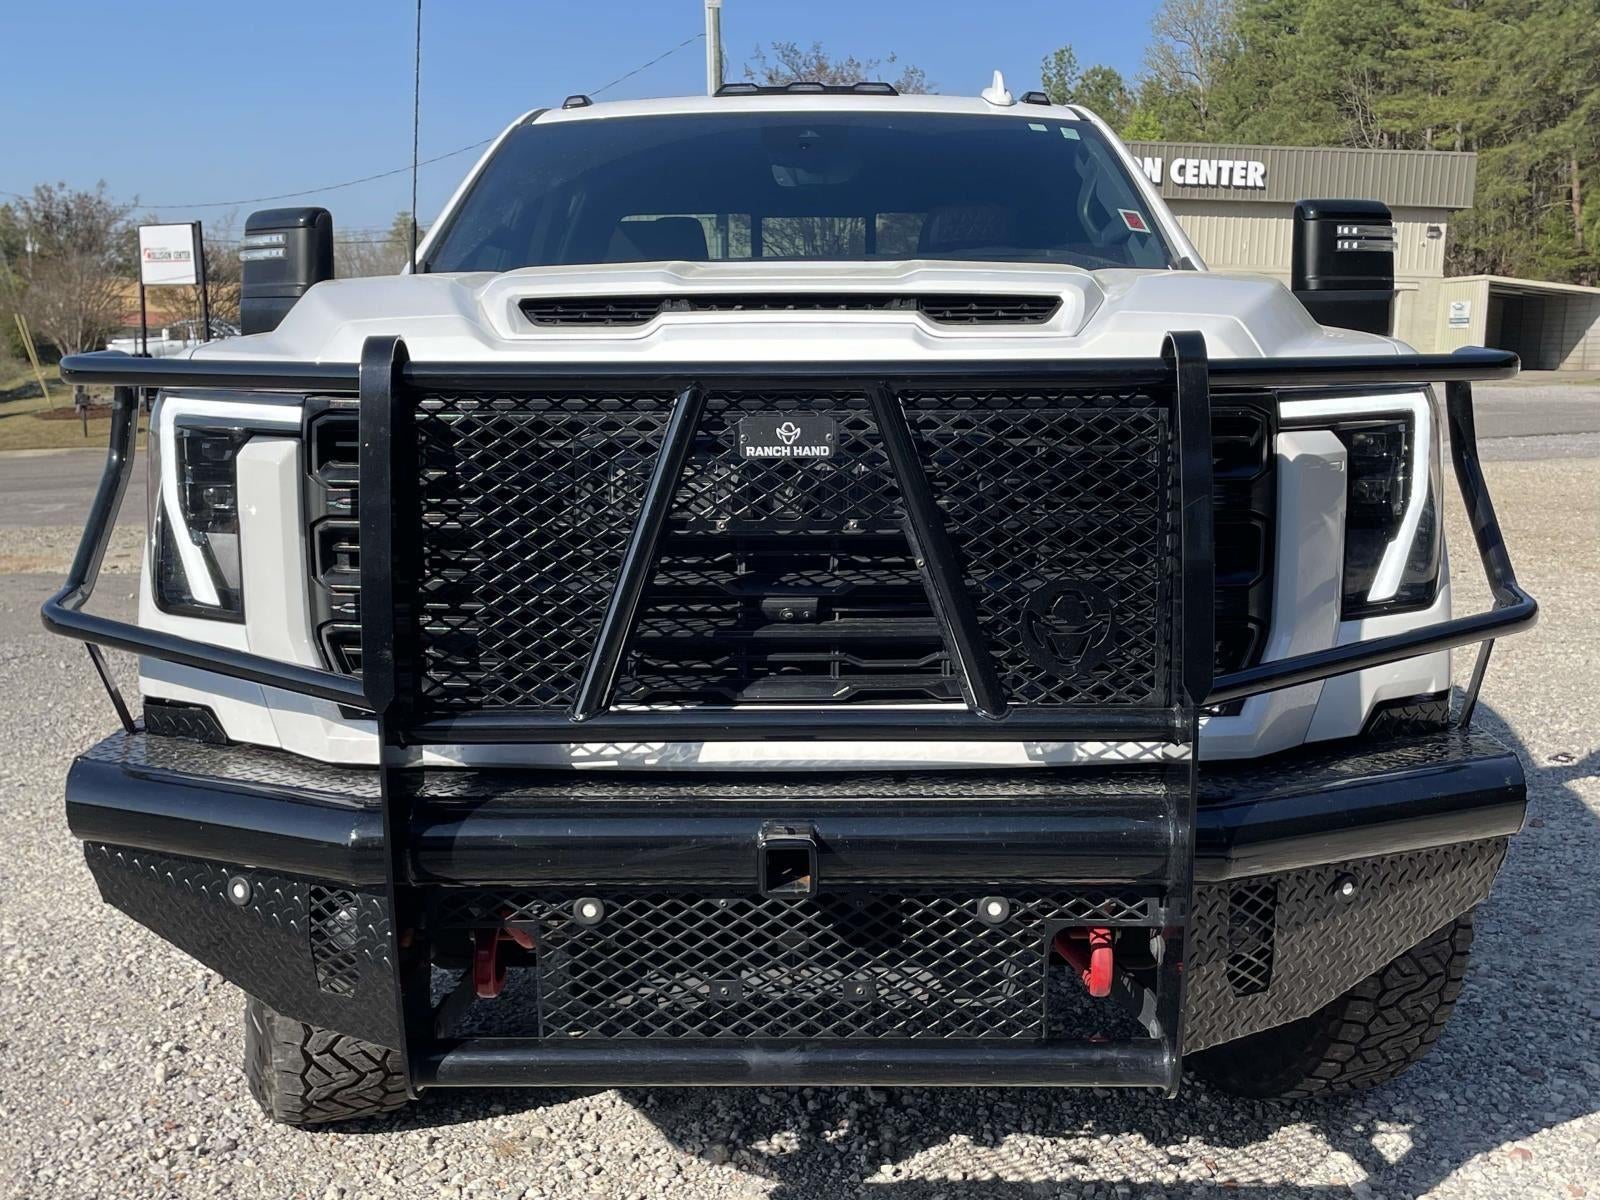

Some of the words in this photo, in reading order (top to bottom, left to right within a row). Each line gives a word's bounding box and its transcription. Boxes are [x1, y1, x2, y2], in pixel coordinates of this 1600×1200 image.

[1169, 158, 1266, 188] CENTER
[746, 446, 791, 457] RANCH
[793, 446, 830, 456] HAND
